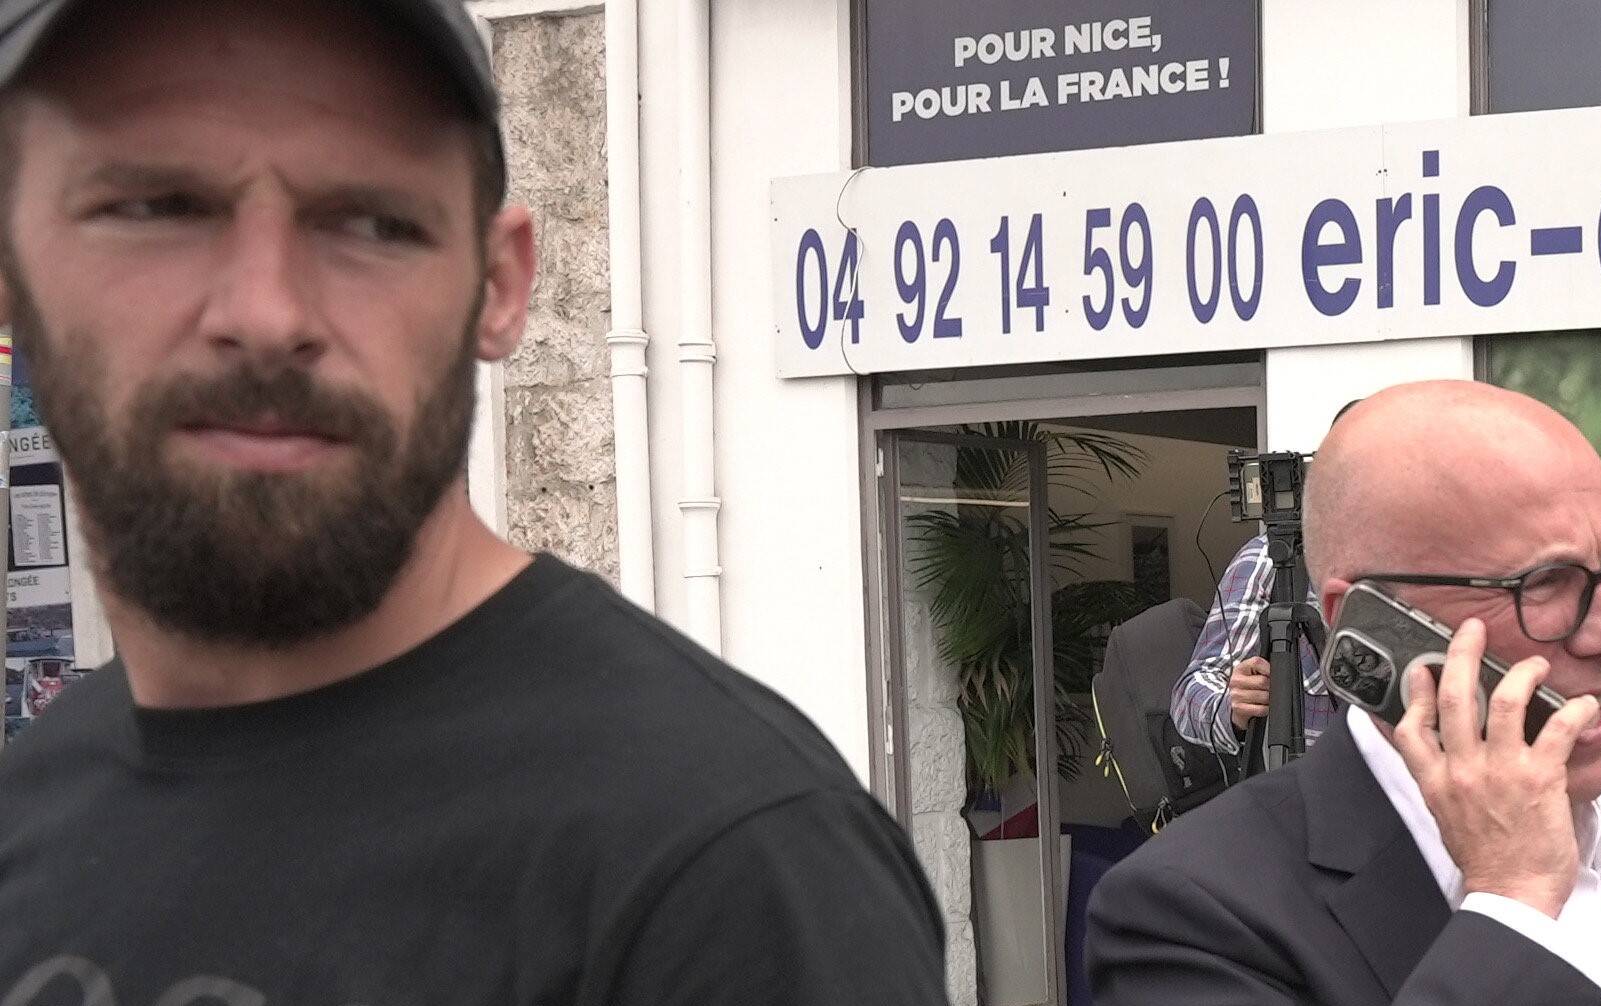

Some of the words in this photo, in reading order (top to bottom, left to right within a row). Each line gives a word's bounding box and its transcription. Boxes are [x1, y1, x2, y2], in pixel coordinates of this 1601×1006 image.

[954, 27, 1057, 68] POUR
[1064, 16, 1162, 54] NICE,
[892, 83, 992, 123] POUR
[1000, 77, 1049, 111] LA
[1057, 59, 1210, 105] FRANCE
[795, 227, 865, 350] 04
[893, 217, 963, 344] 92
[990, 213, 1051, 335] 14
[1082, 202, 1153, 331] 59
[1186, 193, 1264, 325] 00
